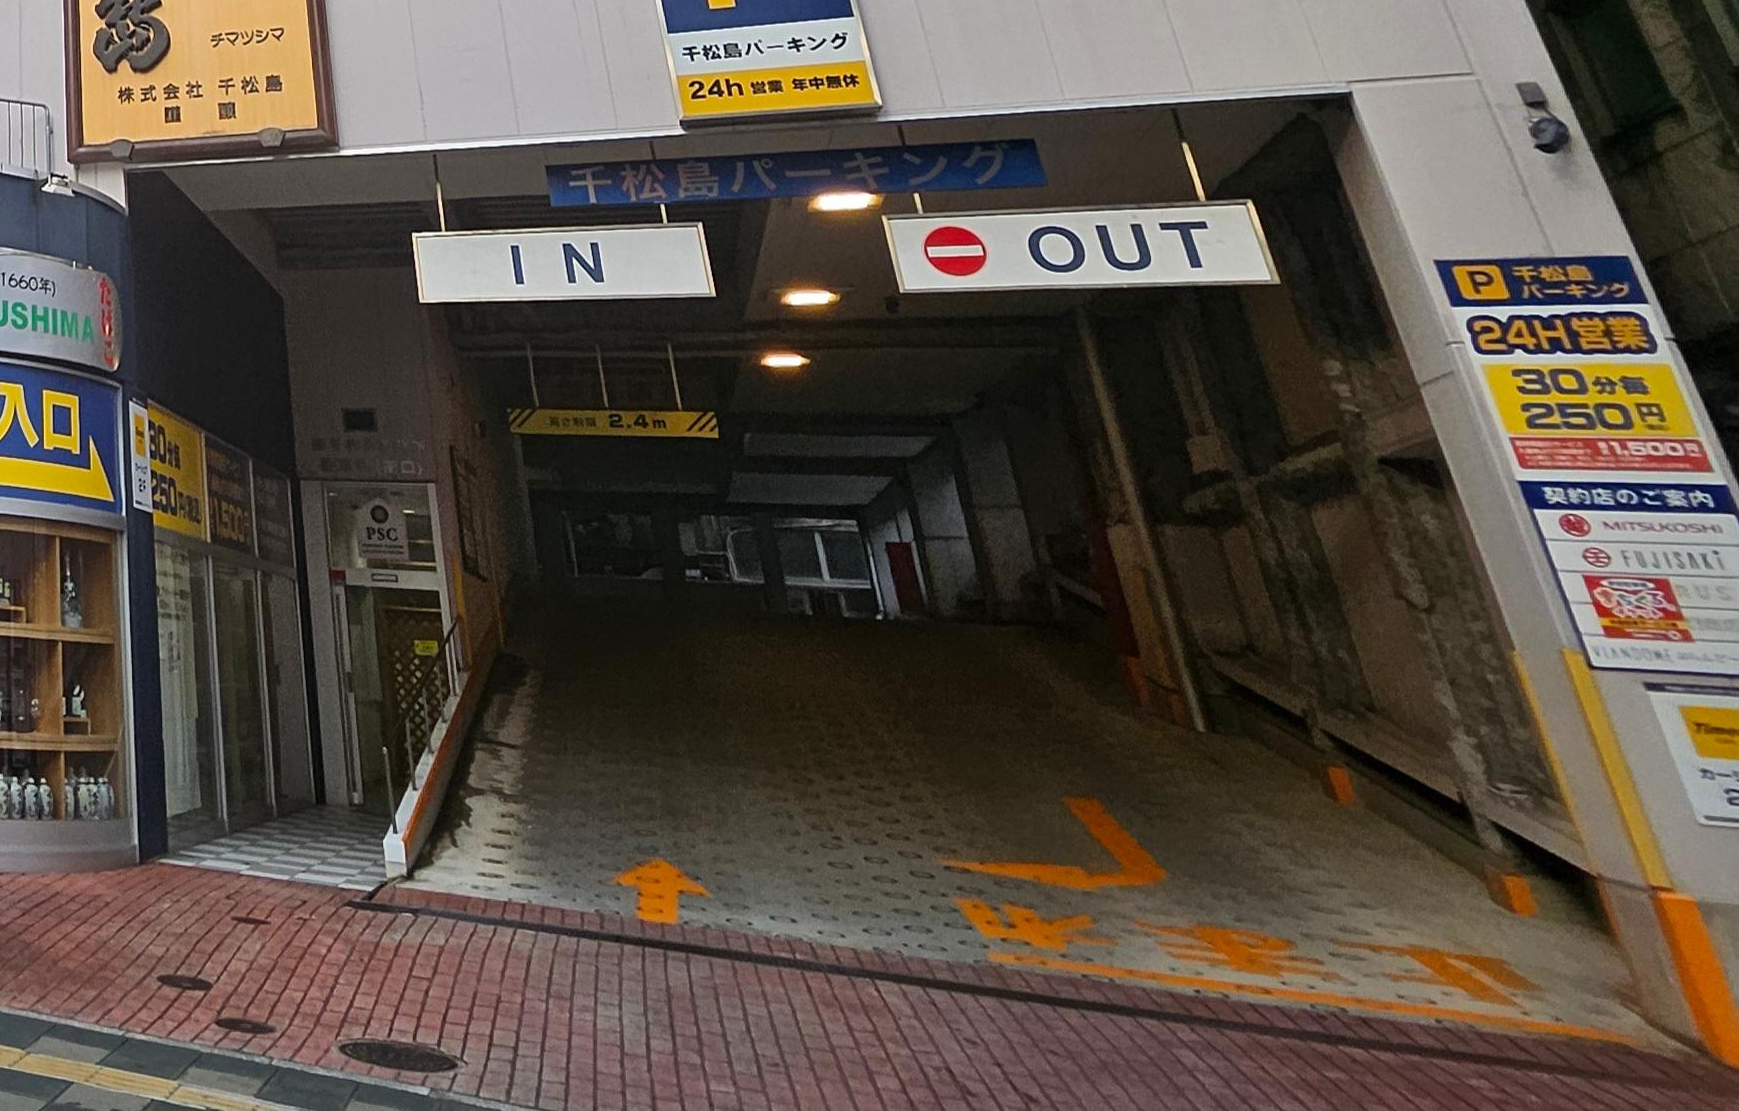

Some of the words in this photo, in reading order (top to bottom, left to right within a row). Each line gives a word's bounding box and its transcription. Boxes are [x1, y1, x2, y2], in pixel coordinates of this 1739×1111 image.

[210, 25, 286, 49] チマツシマ
[681, 32, 850, 63] 千松島パーキング
[117, 80, 205, 106] 株式会社
[217, 74, 284, 96] 千松島
[687, 77, 745, 101] 24h
[750, 79, 785, 95] 営業
[791, 73, 861, 92] 年中無休
[567, 143, 1011, 204] 千松島パーキング
[1027, 220, 1212, 274] OUT
[509, 240, 606, 287] IN
[1511, 264, 1593, 282] 千松島
[1466, 270, 1495, 295] P
[1522, 282, 1630, 300] パーキング
[1471, 314, 1652, 352] 24H営業
[607, 413, 668, 430] 2.4m
[1519, 401, 1668, 431] 250円
[1540, 486, 1716, 509] 契約店のご案内
[366, 527, 399, 542] PSC
[1601, 519, 1725, 535] MITSUKOSHI
